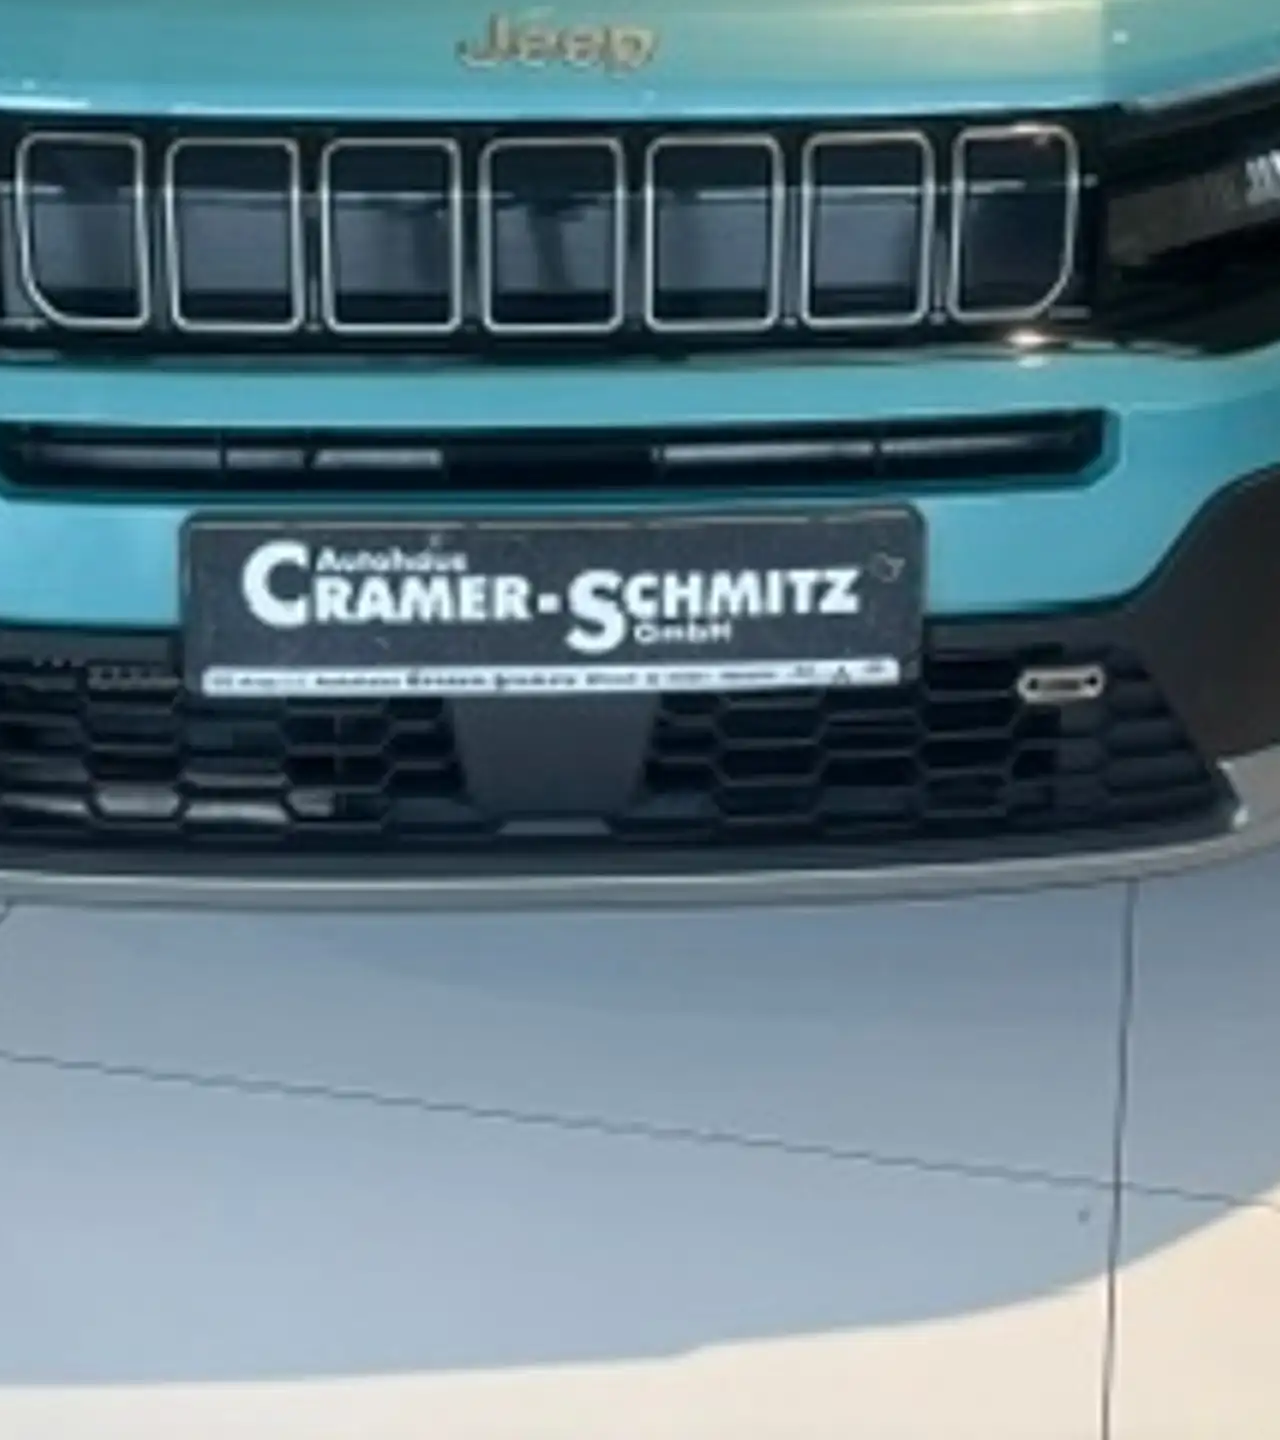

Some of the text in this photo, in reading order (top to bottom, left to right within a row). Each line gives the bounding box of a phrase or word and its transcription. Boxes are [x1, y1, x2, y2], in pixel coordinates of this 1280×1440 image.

[455, 10, 659, 77] Jeep
[316, 546, 468, 572] Autohaus
[632, 618, 733, 646] GmbH
